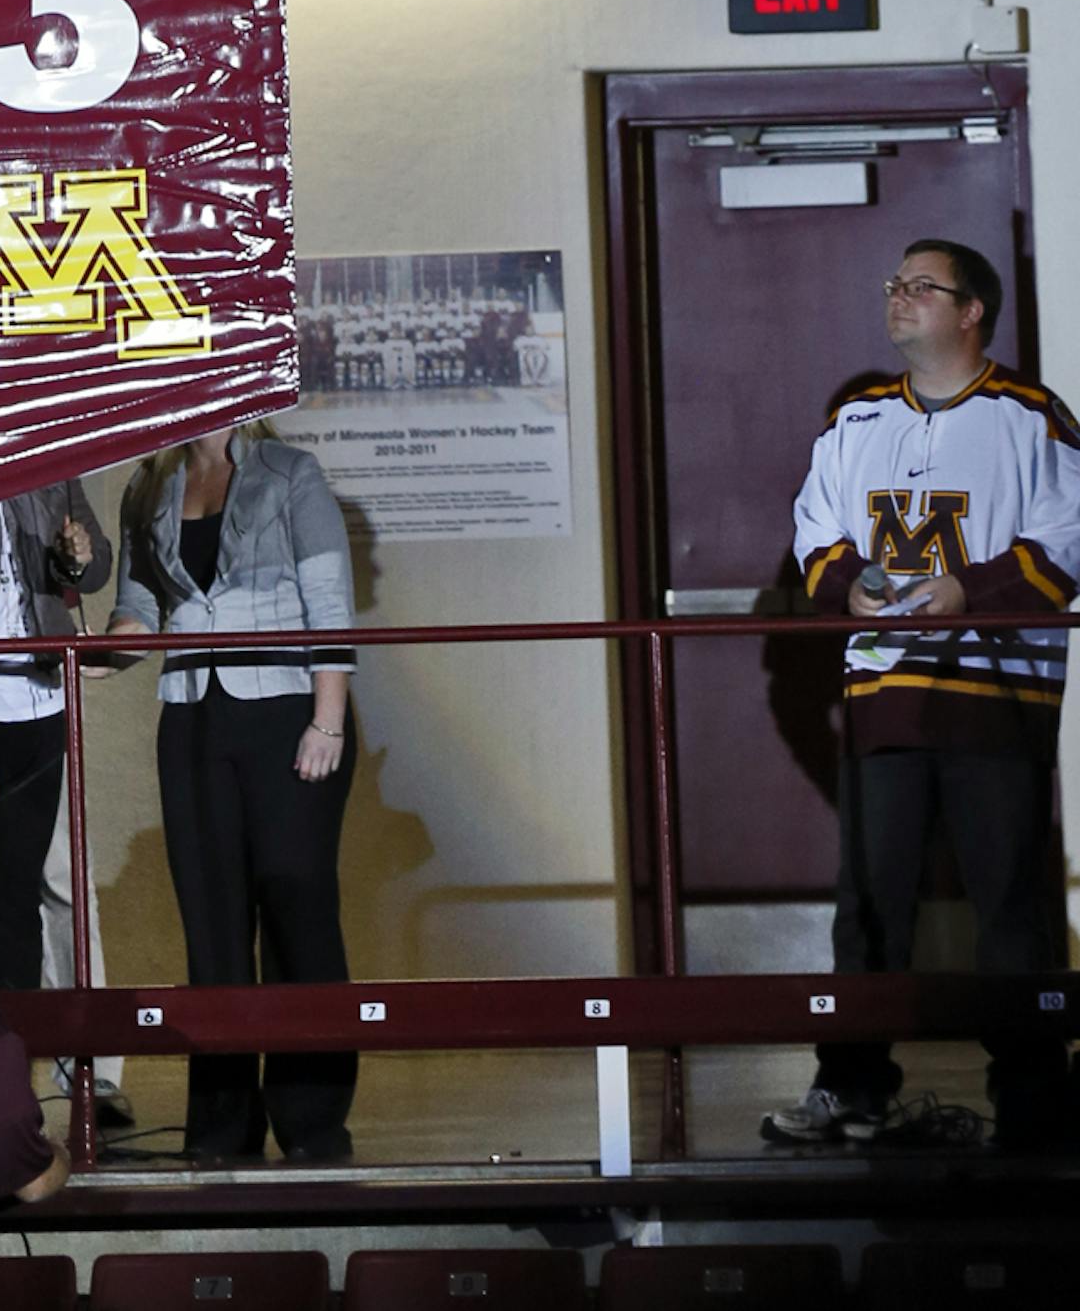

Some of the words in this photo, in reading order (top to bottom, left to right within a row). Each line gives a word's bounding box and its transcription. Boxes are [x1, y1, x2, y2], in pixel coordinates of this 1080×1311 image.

[323, 430, 337, 442] of
[339, 428, 406, 441] Minnesota
[409, 426, 467, 439] Women's
[471, 424, 517, 438] Hockey
[521, 423, 556, 436] Team
[375, 444, 437, 457] 2010-2011
[866, 490, 970, 577] M
[592, 1001, 601, 1015] 8
[817, 997, 827, 1010] 9
[144, 1011, 154, 1024] 6
[367, 1005, 376, 1018] 7
[207, 1280, 219, 1296] 7
